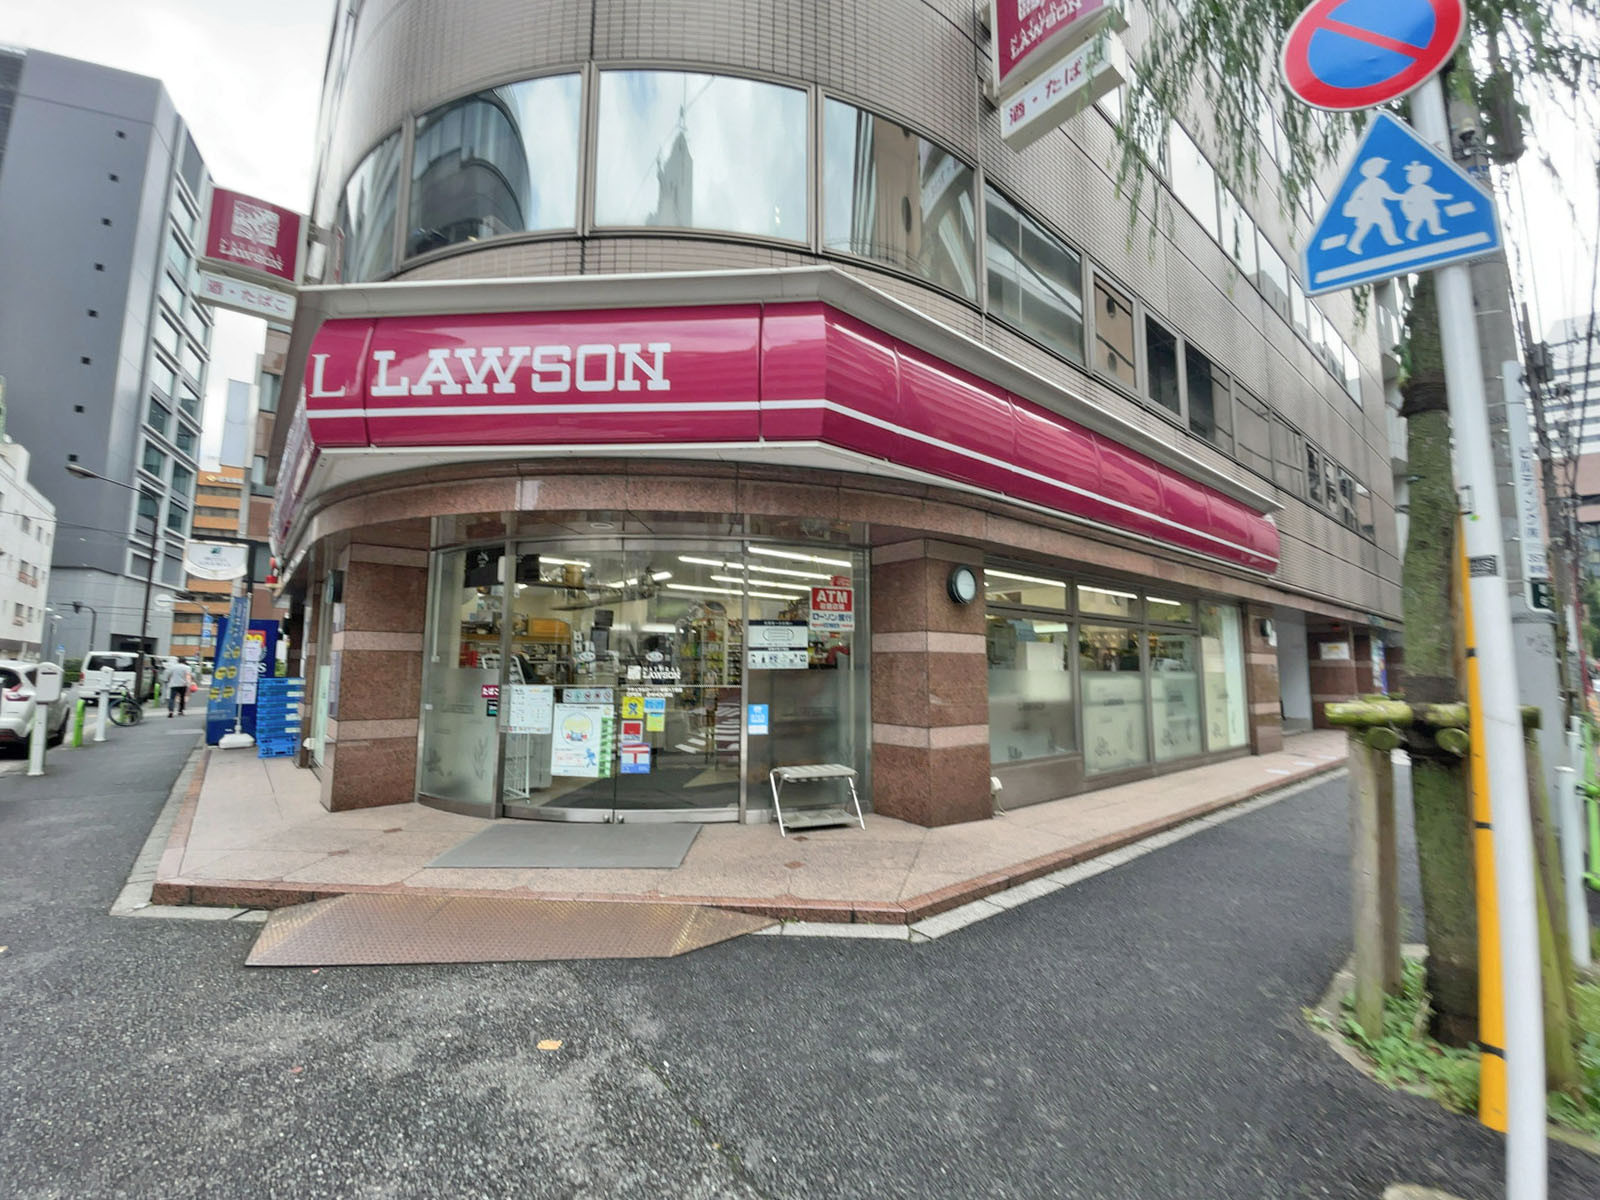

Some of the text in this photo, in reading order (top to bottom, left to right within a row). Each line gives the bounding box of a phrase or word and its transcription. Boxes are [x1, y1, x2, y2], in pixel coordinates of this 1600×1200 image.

[1010, 0, 1082, 60] LAWSON
[309, 353, 346, 398] L
[370, 342, 672, 396] LAWSON
[816, 589, 848, 604] ATM
